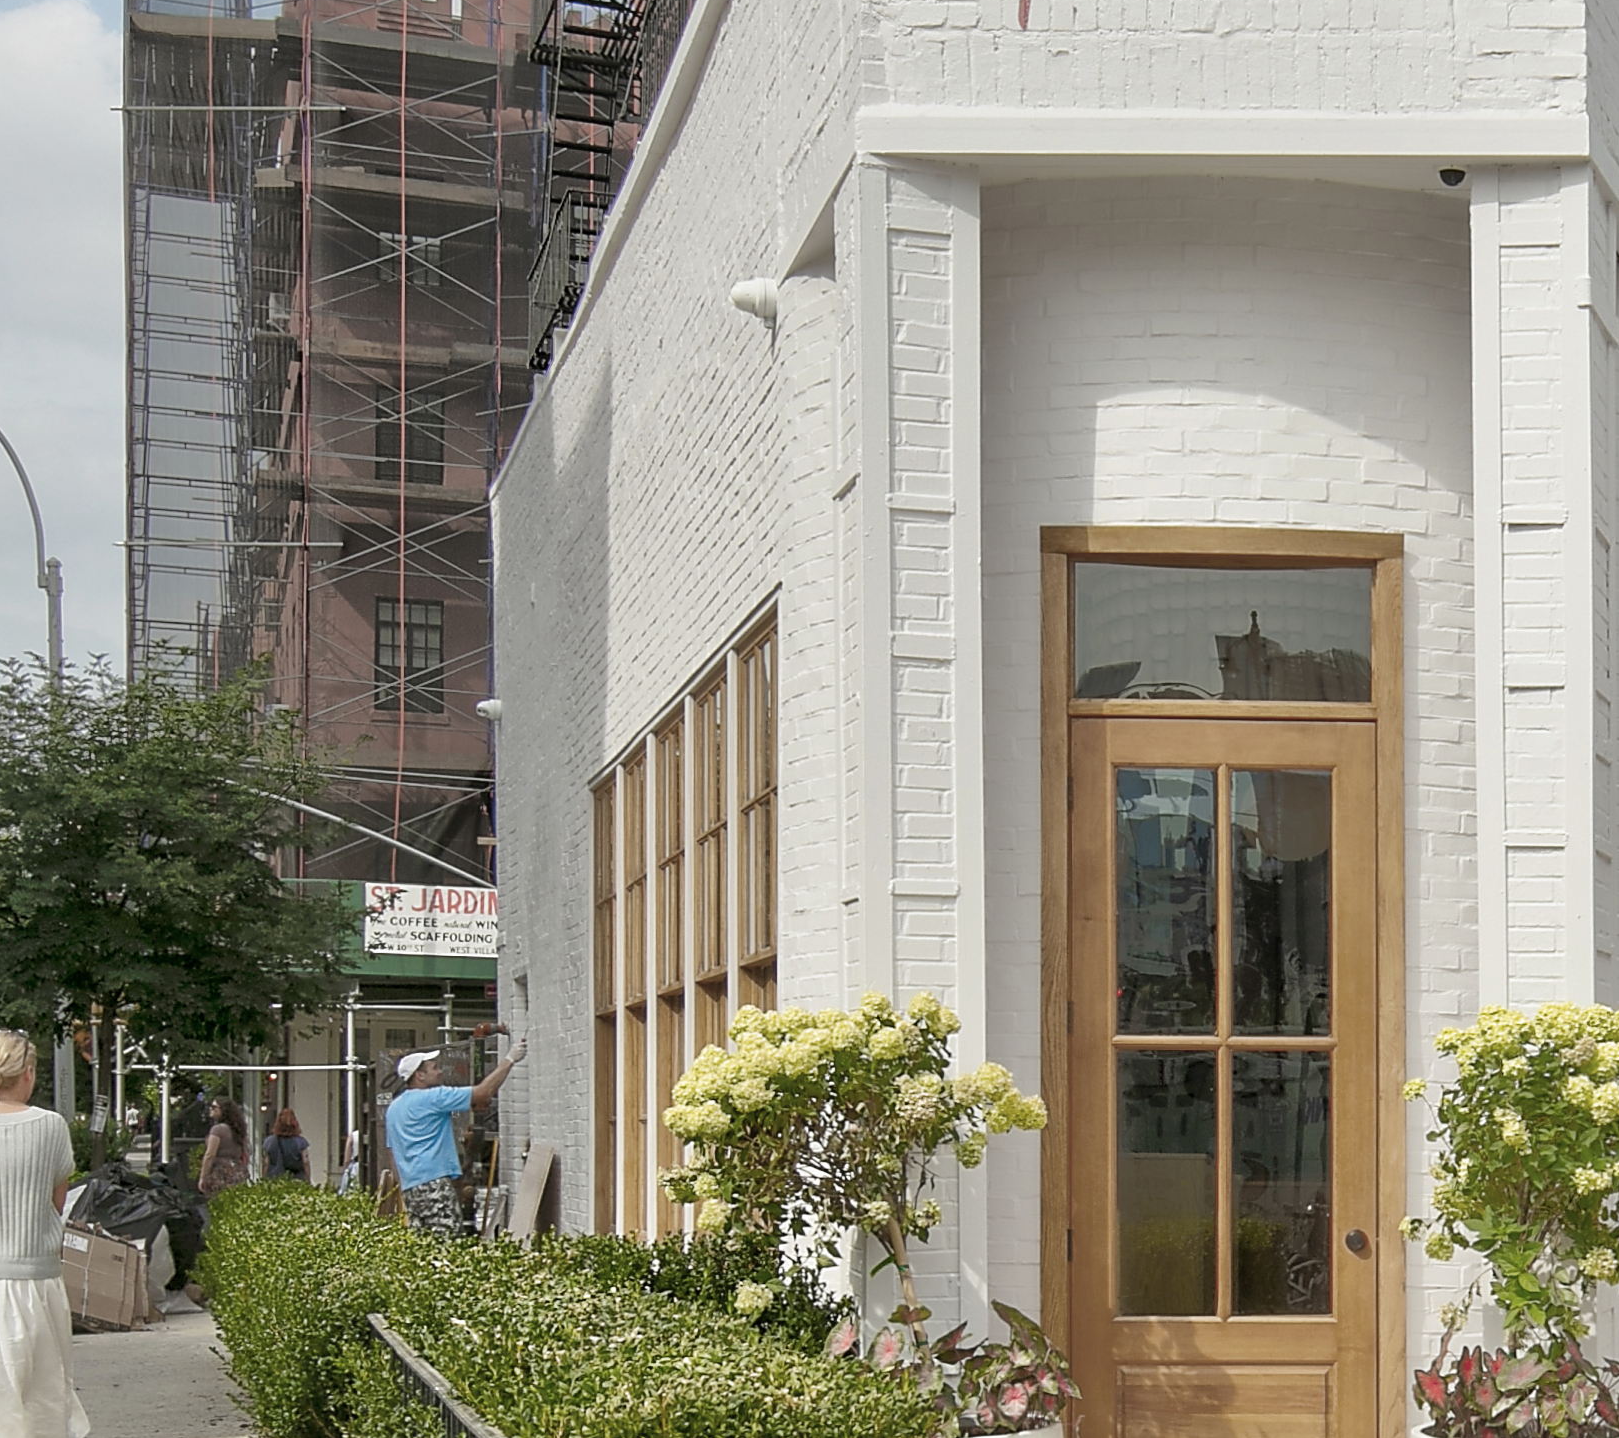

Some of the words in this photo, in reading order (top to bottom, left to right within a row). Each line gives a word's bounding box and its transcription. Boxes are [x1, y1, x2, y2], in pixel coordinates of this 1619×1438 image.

[390, 917, 438, 928] COFFEE
[410, 932, 493, 943] SCAFFOLDING
[449, 946, 470, 954] WEST
